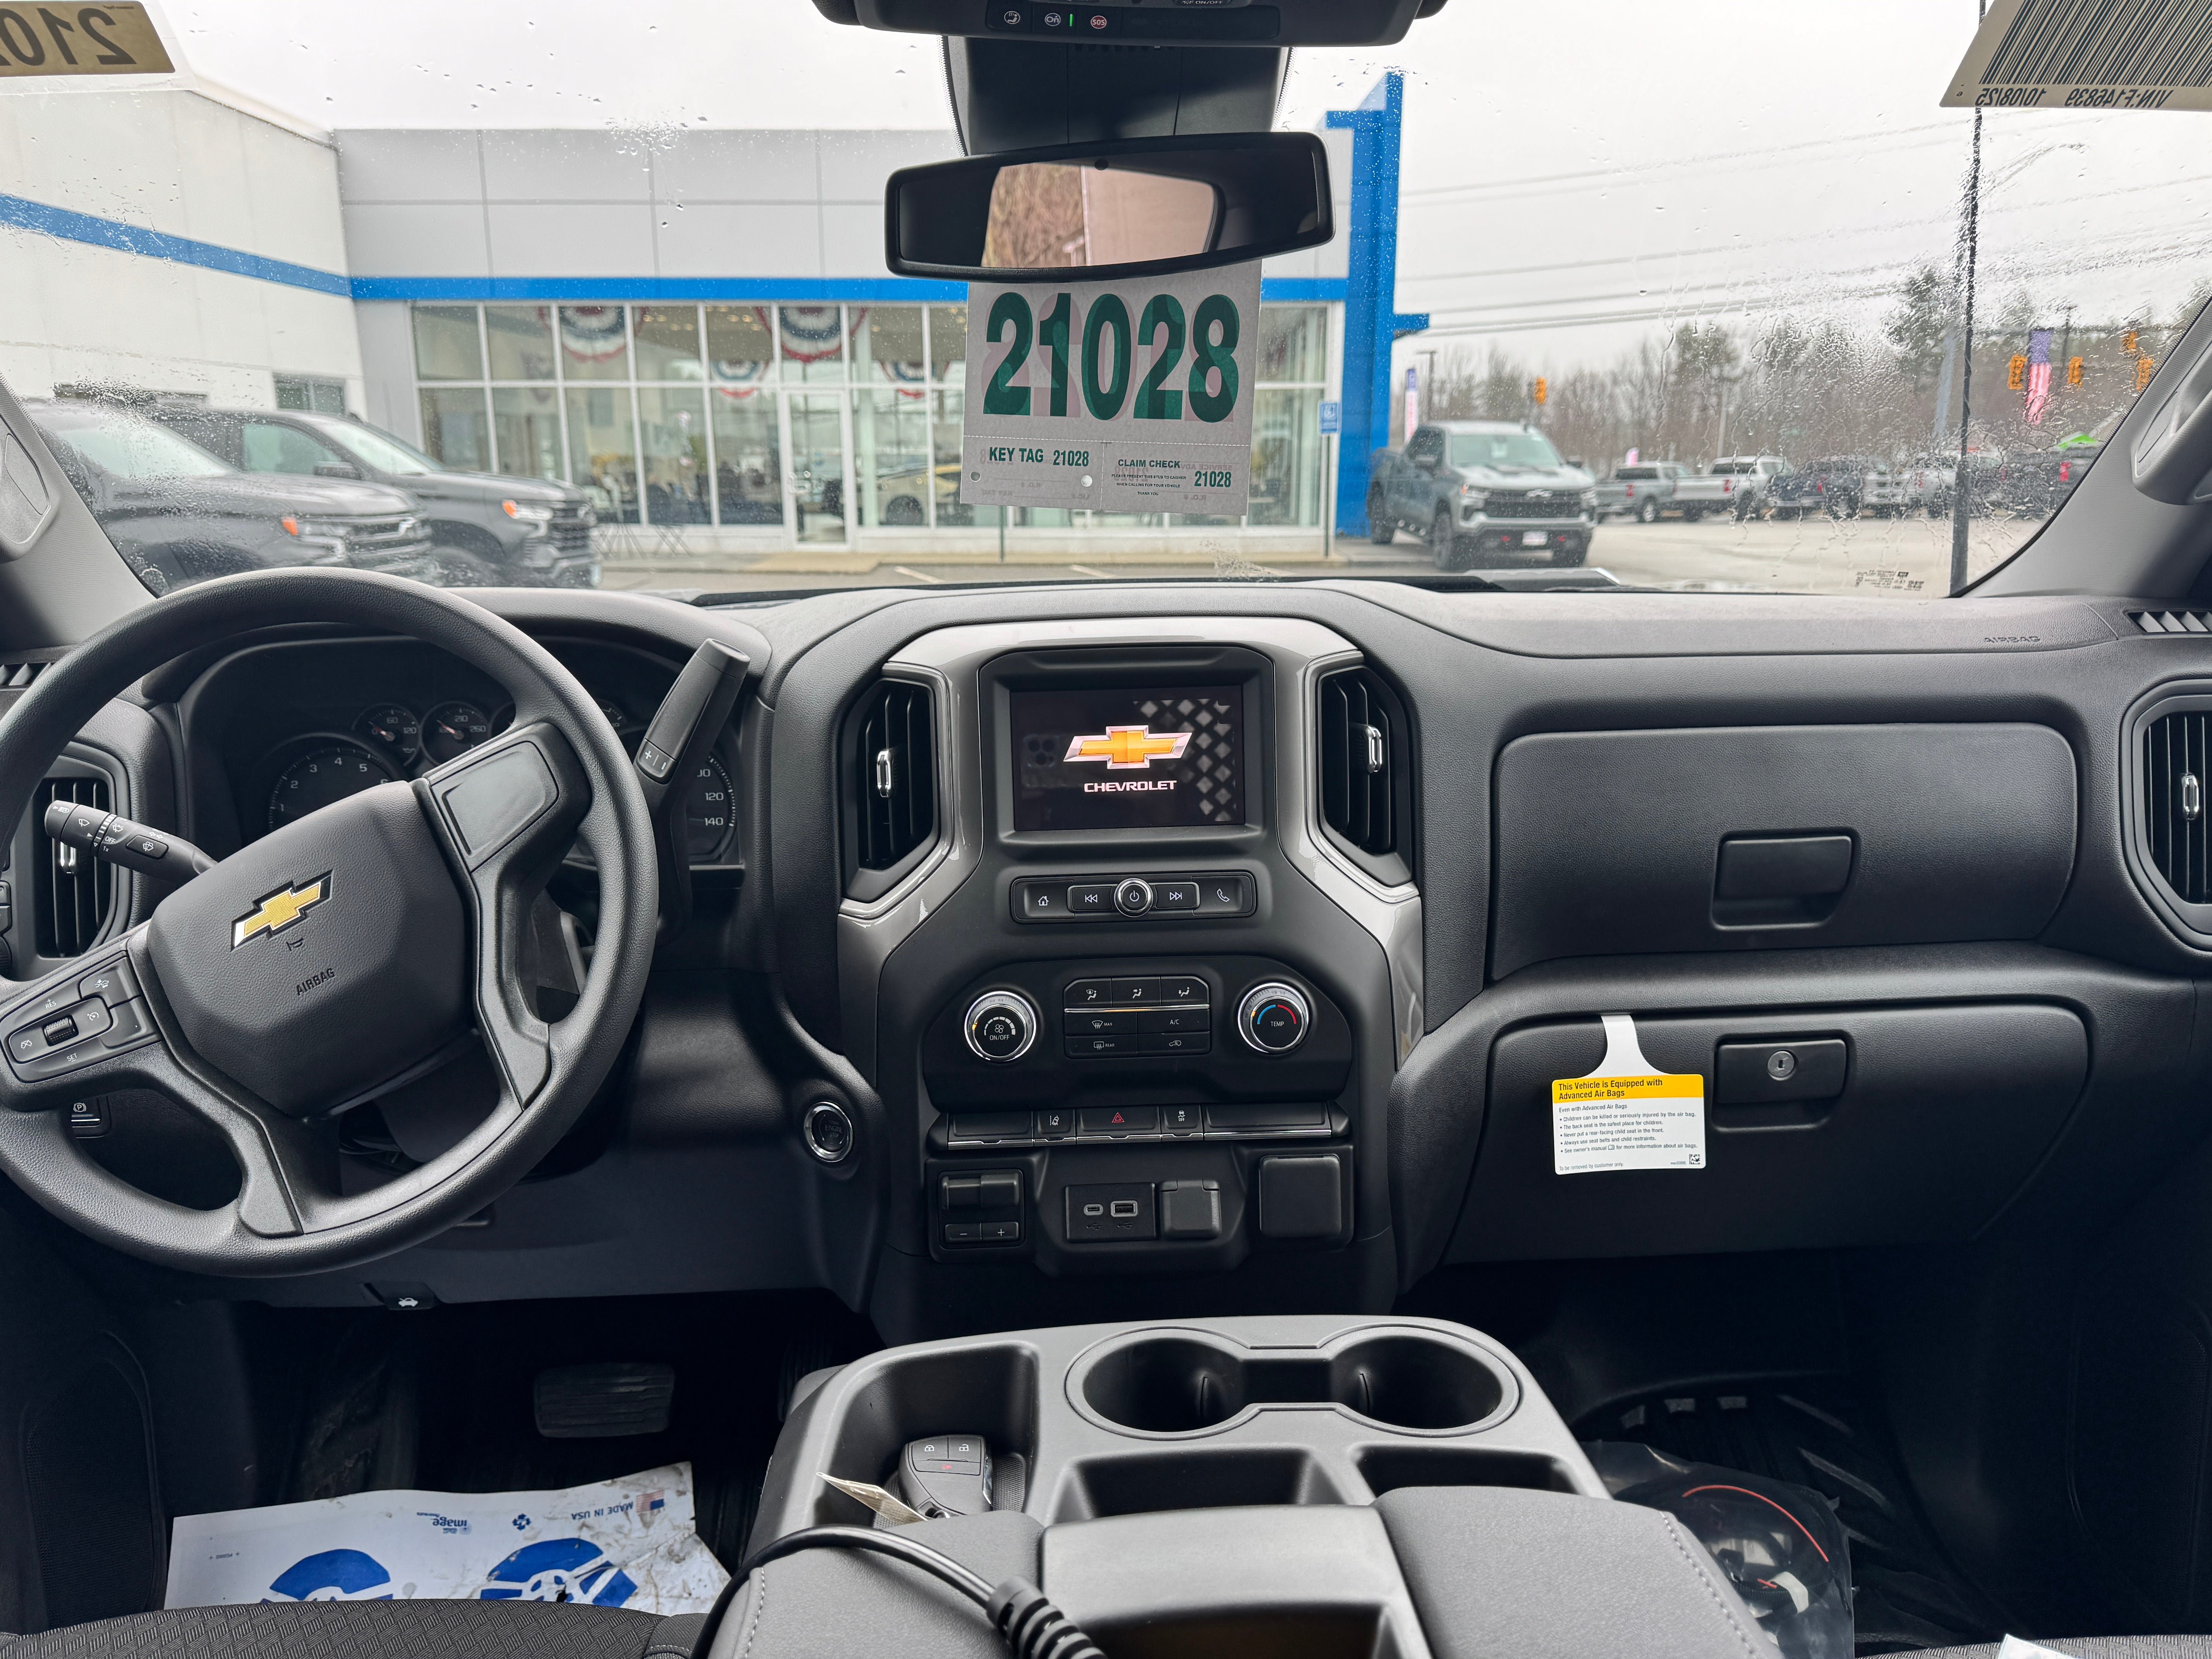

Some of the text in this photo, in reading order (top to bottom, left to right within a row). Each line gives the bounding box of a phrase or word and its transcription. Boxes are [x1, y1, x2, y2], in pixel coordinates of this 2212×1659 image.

[983, 292, 1240, 422] 21028
[989, 447, 1044, 463] KEY TAG
[1053, 450, 1089, 467] 21028
[1118, 459, 1180, 468] CLAIM CHECK
[1194, 471, 1232, 488] 21028
[335, 757, 342, 766] 4
[310, 764, 318, 773] 3
[359, 764, 368, 772] 5
[290, 780, 298, 789] 2
[1084, 780, 1177, 792] CHEVROLET
[705, 792, 724, 801] 120
[280, 804, 285, 812] 1
[704, 817, 724, 826] 140
[297, 968, 335, 996] AIRBAG
[45, 1001, 57, 1009] RES
[67, 1053, 77, 1061] SET
[1575, 1081, 1600, 1090] Vehicle
[1611, 1079, 1644, 1088] Equipped
[1559, 1091, 1592, 1100] Advanced
[1607, 1090, 1625, 1098] Bags
[571, 1501, 634, 1520] MADE IN USA
[433, 1516, 467, 1529] image
